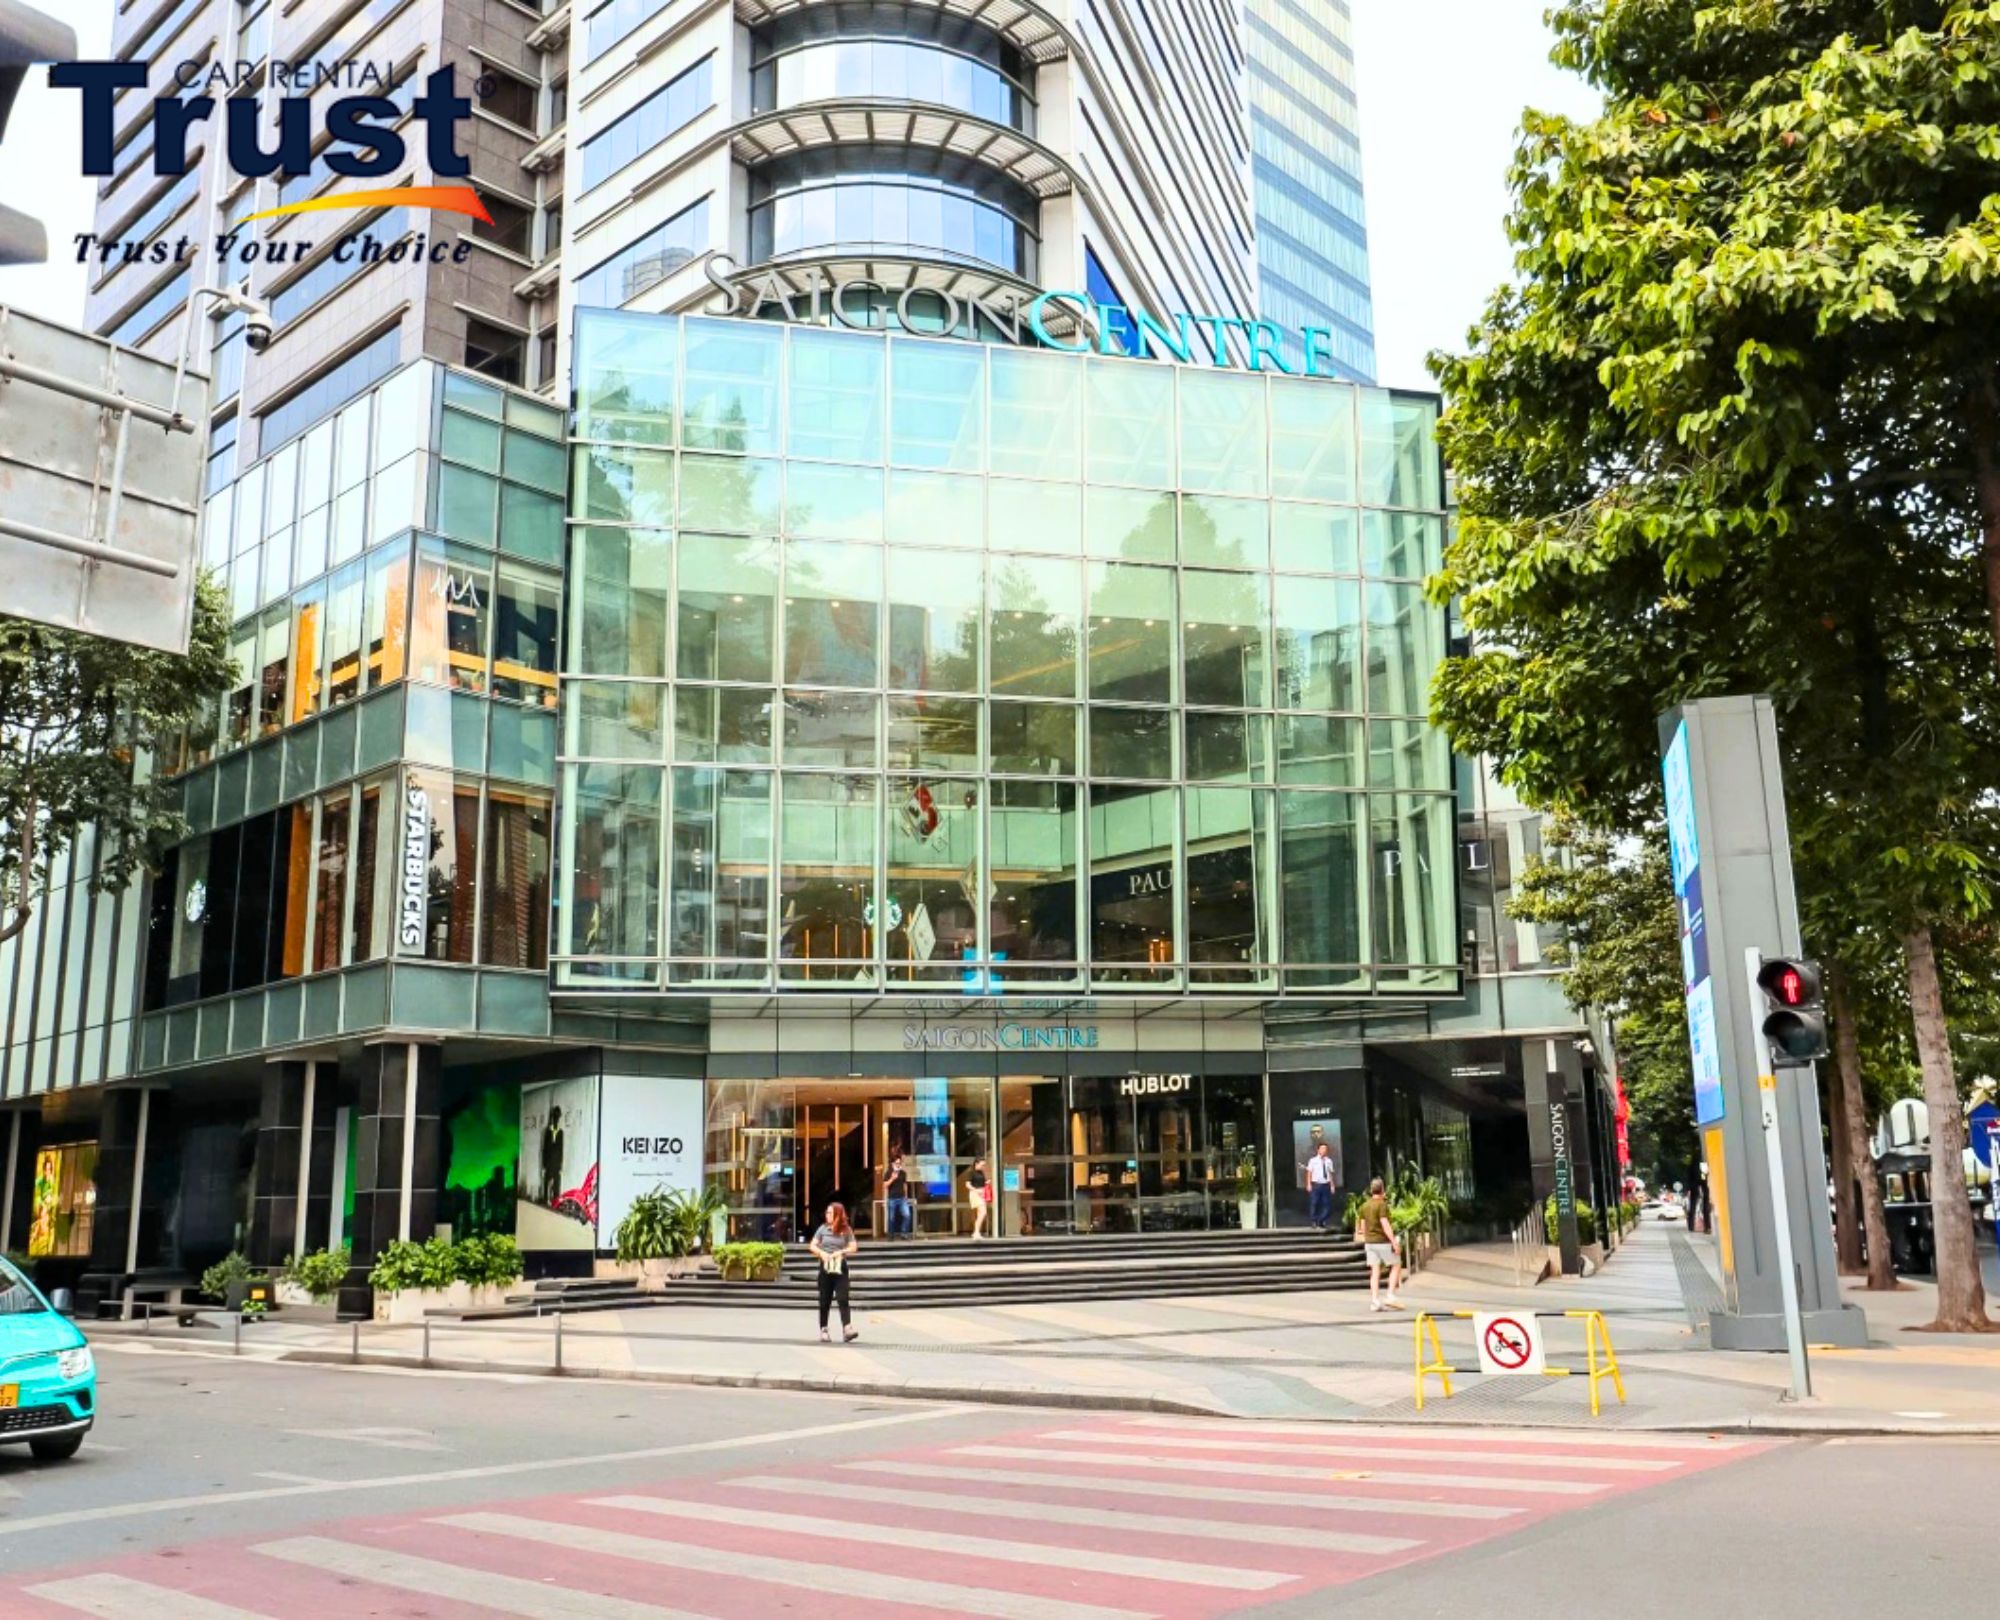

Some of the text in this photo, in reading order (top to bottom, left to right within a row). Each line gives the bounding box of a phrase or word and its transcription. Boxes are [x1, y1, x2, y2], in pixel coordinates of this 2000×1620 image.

[401, 789, 428, 946] STARBUCKS
[1120, 1073, 1192, 1096] HUBLOT
[622, 1136, 684, 1155] KENZO
